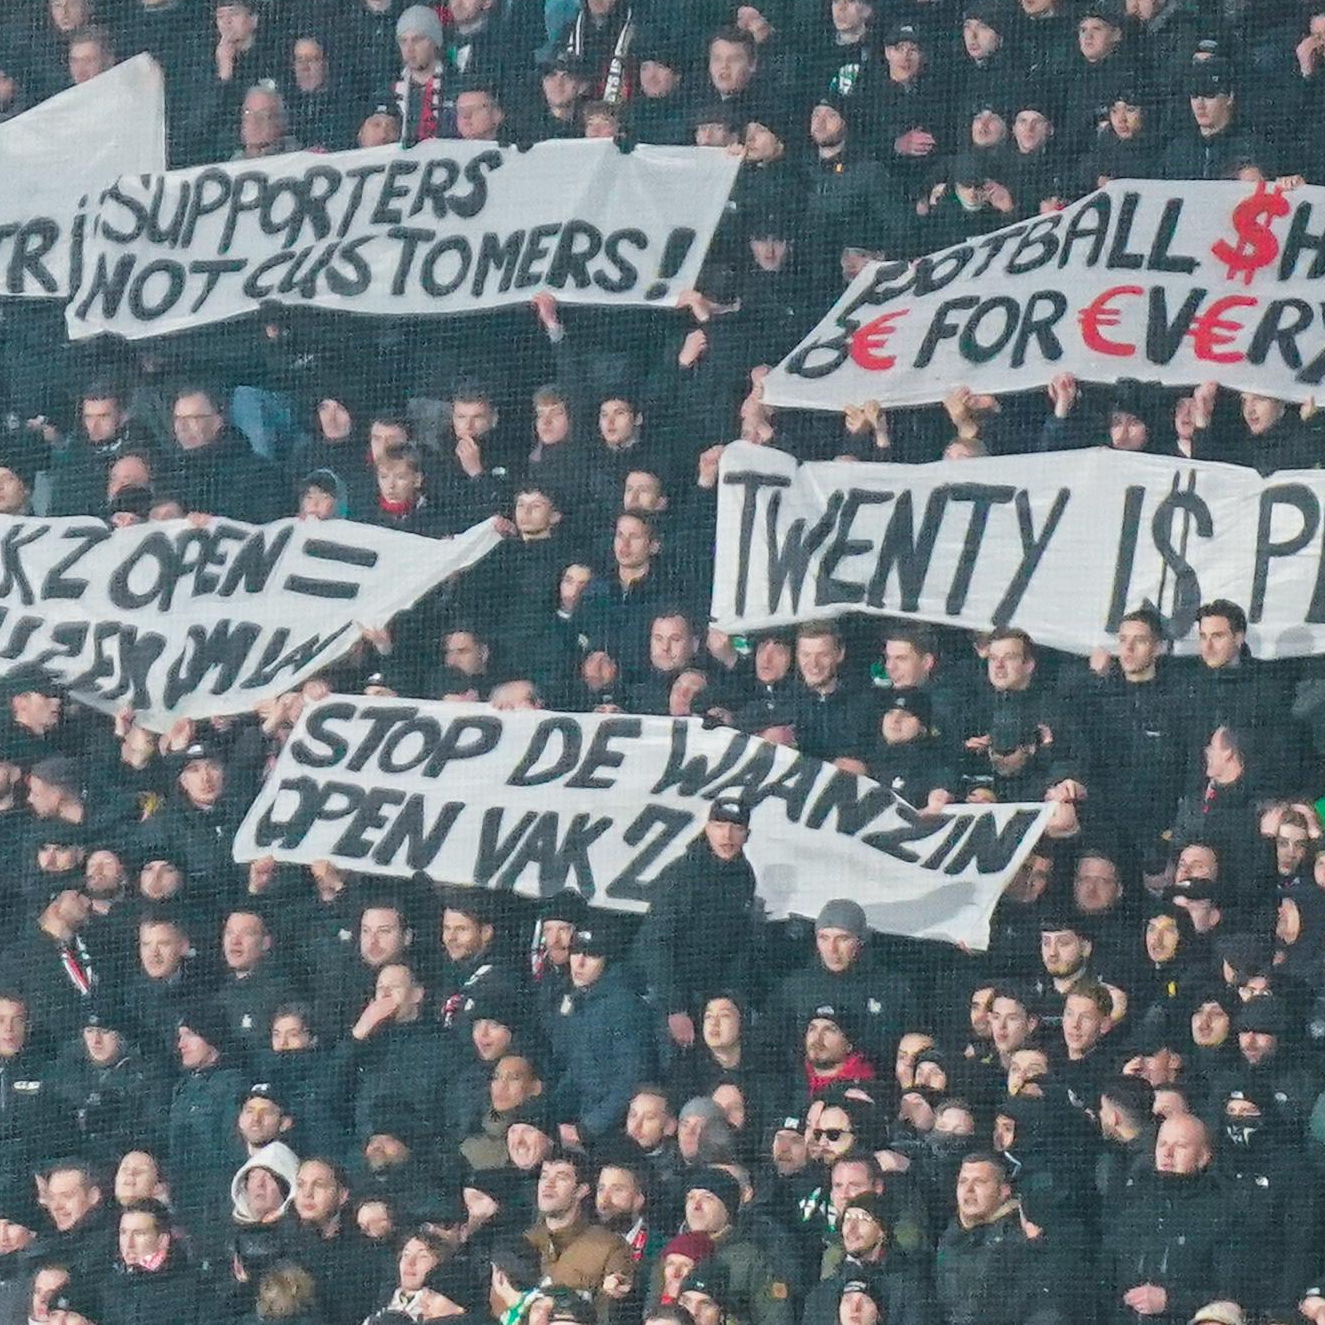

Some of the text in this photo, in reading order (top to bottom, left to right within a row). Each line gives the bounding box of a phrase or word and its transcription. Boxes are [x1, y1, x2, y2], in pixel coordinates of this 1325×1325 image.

[94, 149, 504, 254] SUPPORTERS
[75, 251, 249, 323] NOT
[913, 289, 1068, 369] FOR
[107, 524, 295, 614] OPEN
[723, 469, 1071, 631] TWENTY
[255, 775, 462, 870] OPEN
[473, 805, 616, 895] VAK
[290, 702, 1043, 875] STOP DE WAANZIN
